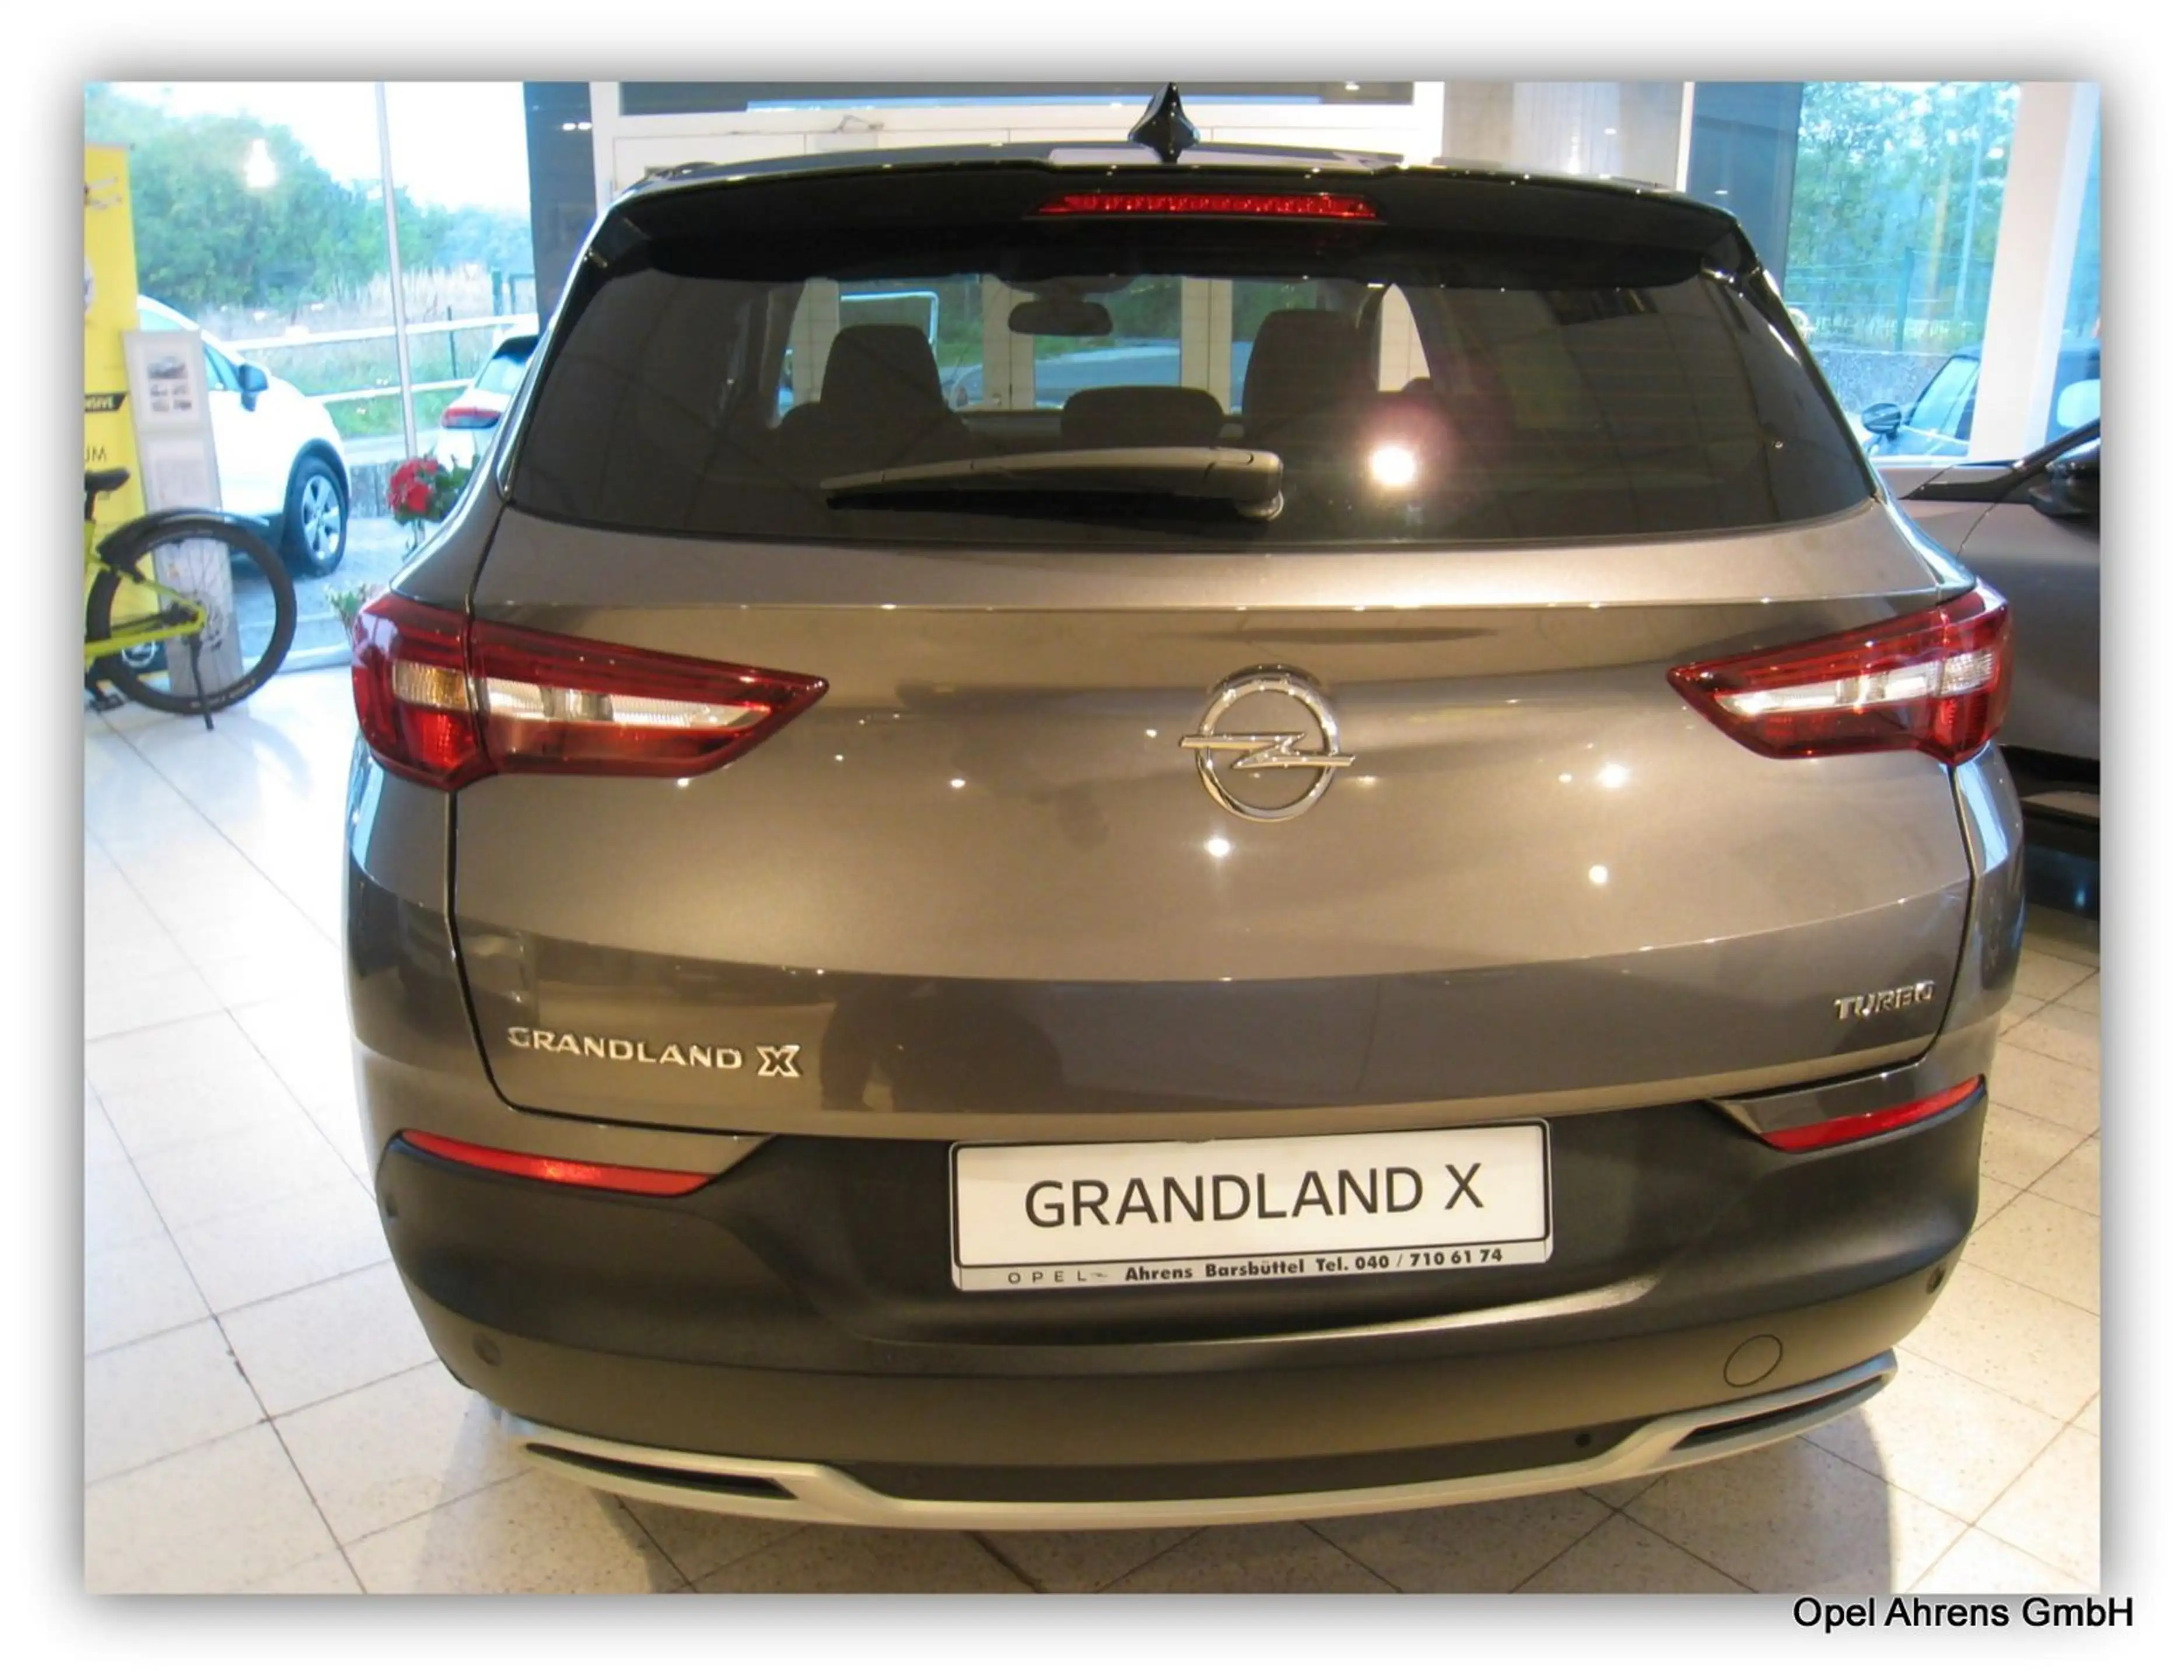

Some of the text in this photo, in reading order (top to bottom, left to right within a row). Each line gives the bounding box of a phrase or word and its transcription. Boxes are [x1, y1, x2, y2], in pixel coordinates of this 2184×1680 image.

[1834, 979, 1935, 1020] TURBO
[508, 1026, 802, 1078] GRANDLAND X
[1025, 1162, 1485, 1228] GRANDLAND X
[1007, 1270, 1087, 1284] OPEL
[1125, 1266, 1194, 1282] Ahrens
[1205, 1259, 1305, 1278] Barsbüttel
[1316, 1257, 1349, 1272] Tel.
[1354, 1255, 1390, 1270] 040
[1409, 1251, 1446, 1267] 710
[1450, 1250, 1472, 1264] 61
[1479, 1248, 1503, 1262] 74
